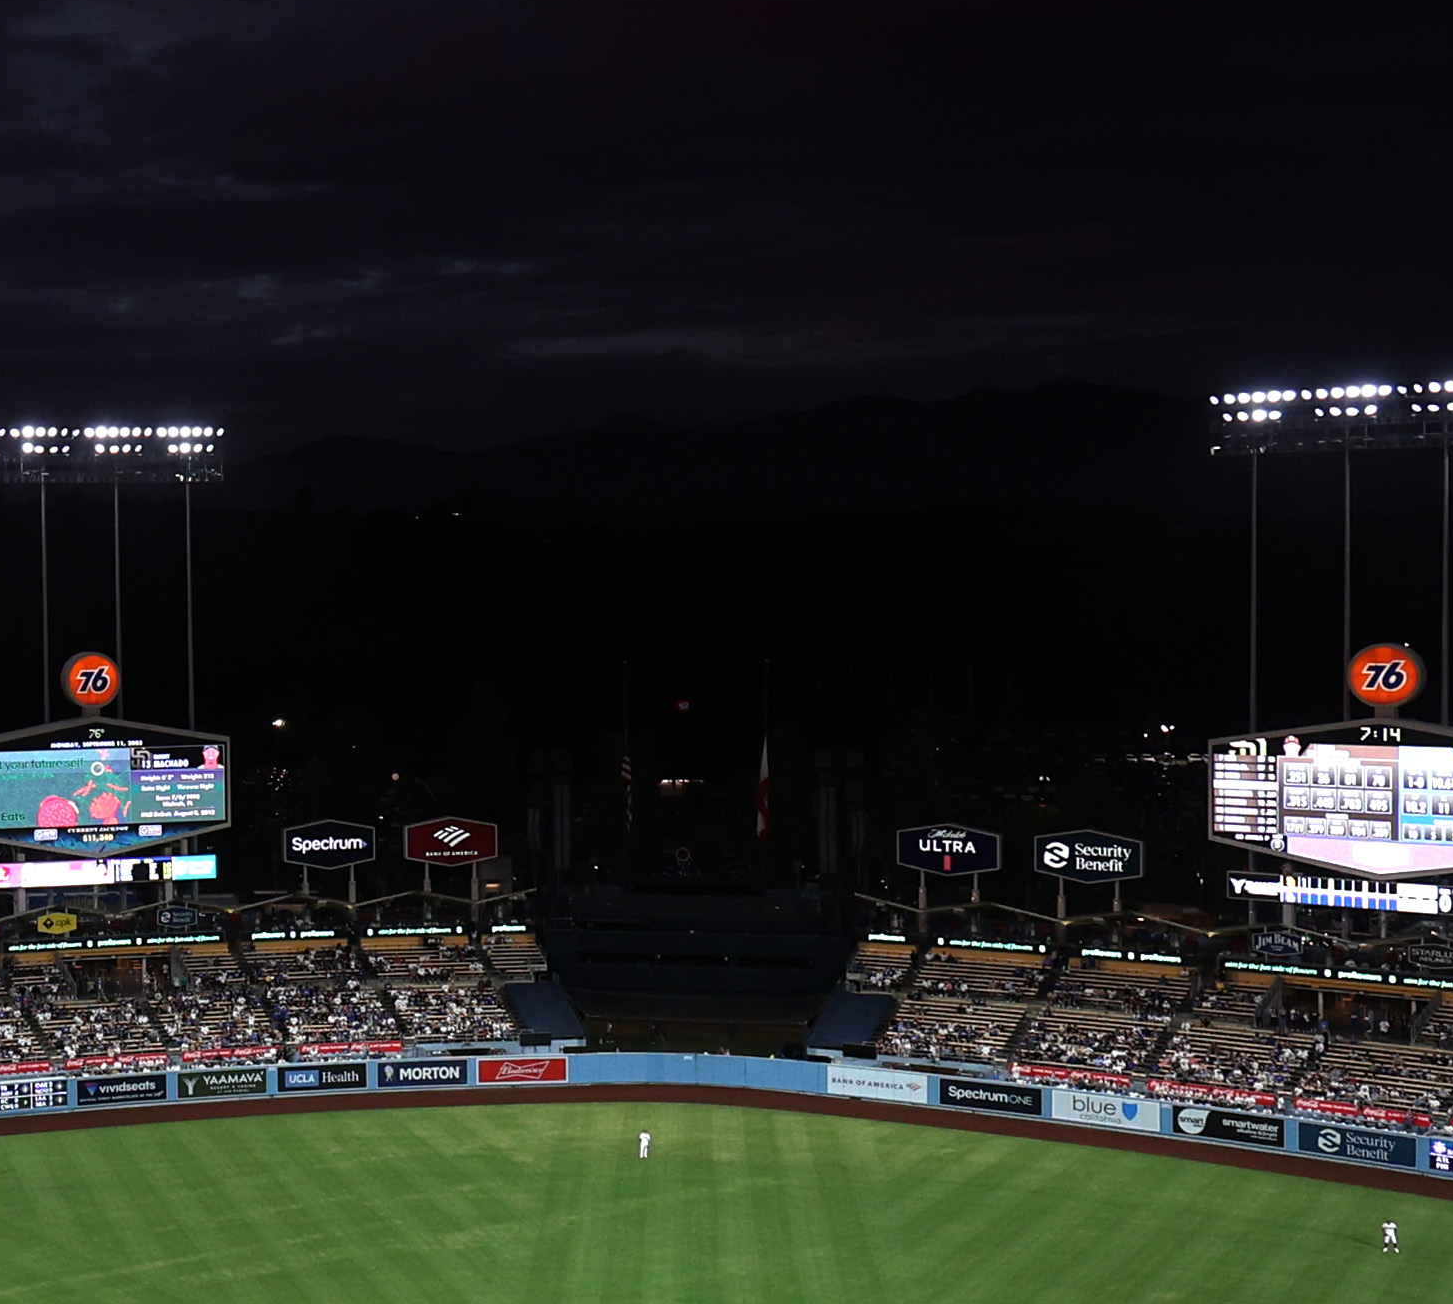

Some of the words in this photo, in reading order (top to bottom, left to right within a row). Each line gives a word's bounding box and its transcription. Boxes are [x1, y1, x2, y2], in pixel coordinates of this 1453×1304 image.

[76, 665, 111, 694] 76
[1361, 660, 1406, 691] 76
[89, 729, 105, 739] 76°
[1360, 727, 1401, 741] 7:14
[5, 762, 29, 771] your
[31, 759, 63, 769] future
[153, 759, 189, 769] MACHADO
[1, 812, 25, 821] Eats
[292, 836, 363, 854] Spectrum
[919, 839, 977, 854] ULTRA
[1075, 843, 1131, 861] Security
[1075, 858, 1124, 873] Benefit
[55, 918, 71, 928] cpk
[1255, 935, 1273, 947] JIM
[1274, 933, 1299, 949] BEAM
[289, 1073, 315, 1083] UCLA
[322, 1070, 359, 1083] Health
[399, 1066, 460, 1080] MORTON
[99, 1080, 156, 1094] vividseats
[832, 1077, 854, 1086] BANK
[867, 1081, 904, 1090] AMERICA
[1072, 1095, 1117, 1115] blue
[1080, 1113, 1122, 1124] california
[1179, 1115, 1204, 1125] smart
[1222, 1118, 1279, 1134] smartwater
[1346, 1132, 1395, 1150] Security
[1346, 1147, 1390, 1161] Benefit
